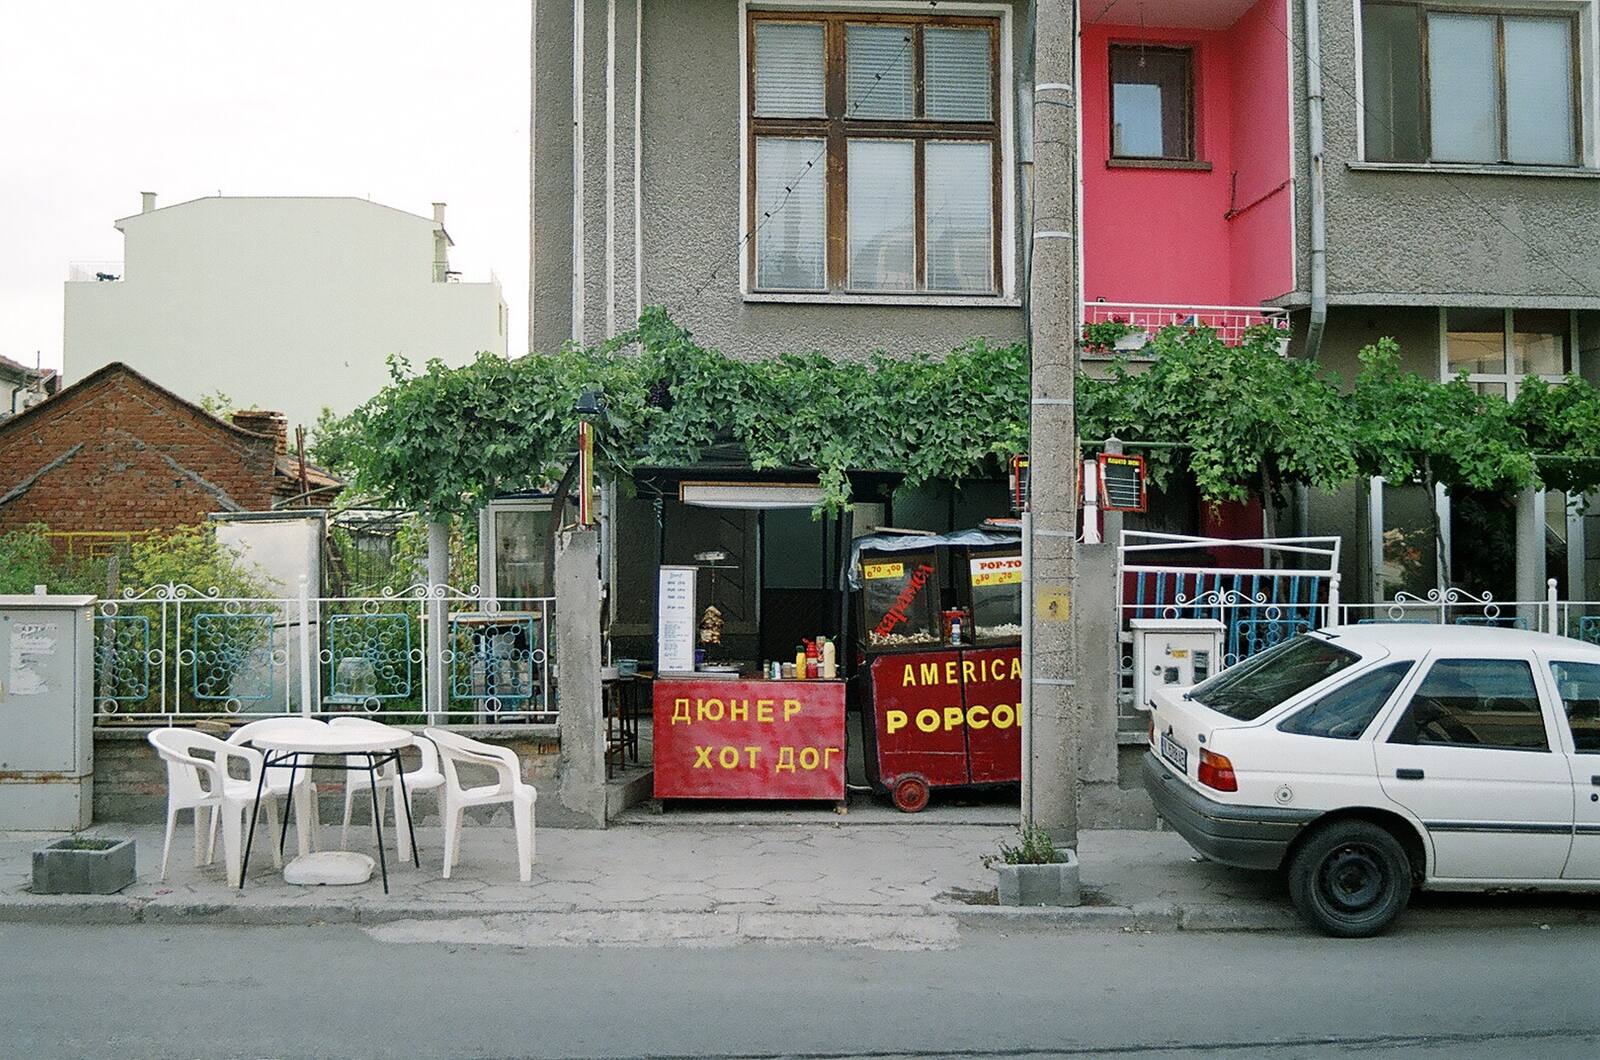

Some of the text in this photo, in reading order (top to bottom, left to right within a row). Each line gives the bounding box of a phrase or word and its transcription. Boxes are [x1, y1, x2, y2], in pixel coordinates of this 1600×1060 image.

[902, 657, 1022, 687] AMERICA
[671, 698, 802, 725] ДЮНЕР
[692, 746, 840, 774] ХОТ ДОГ
